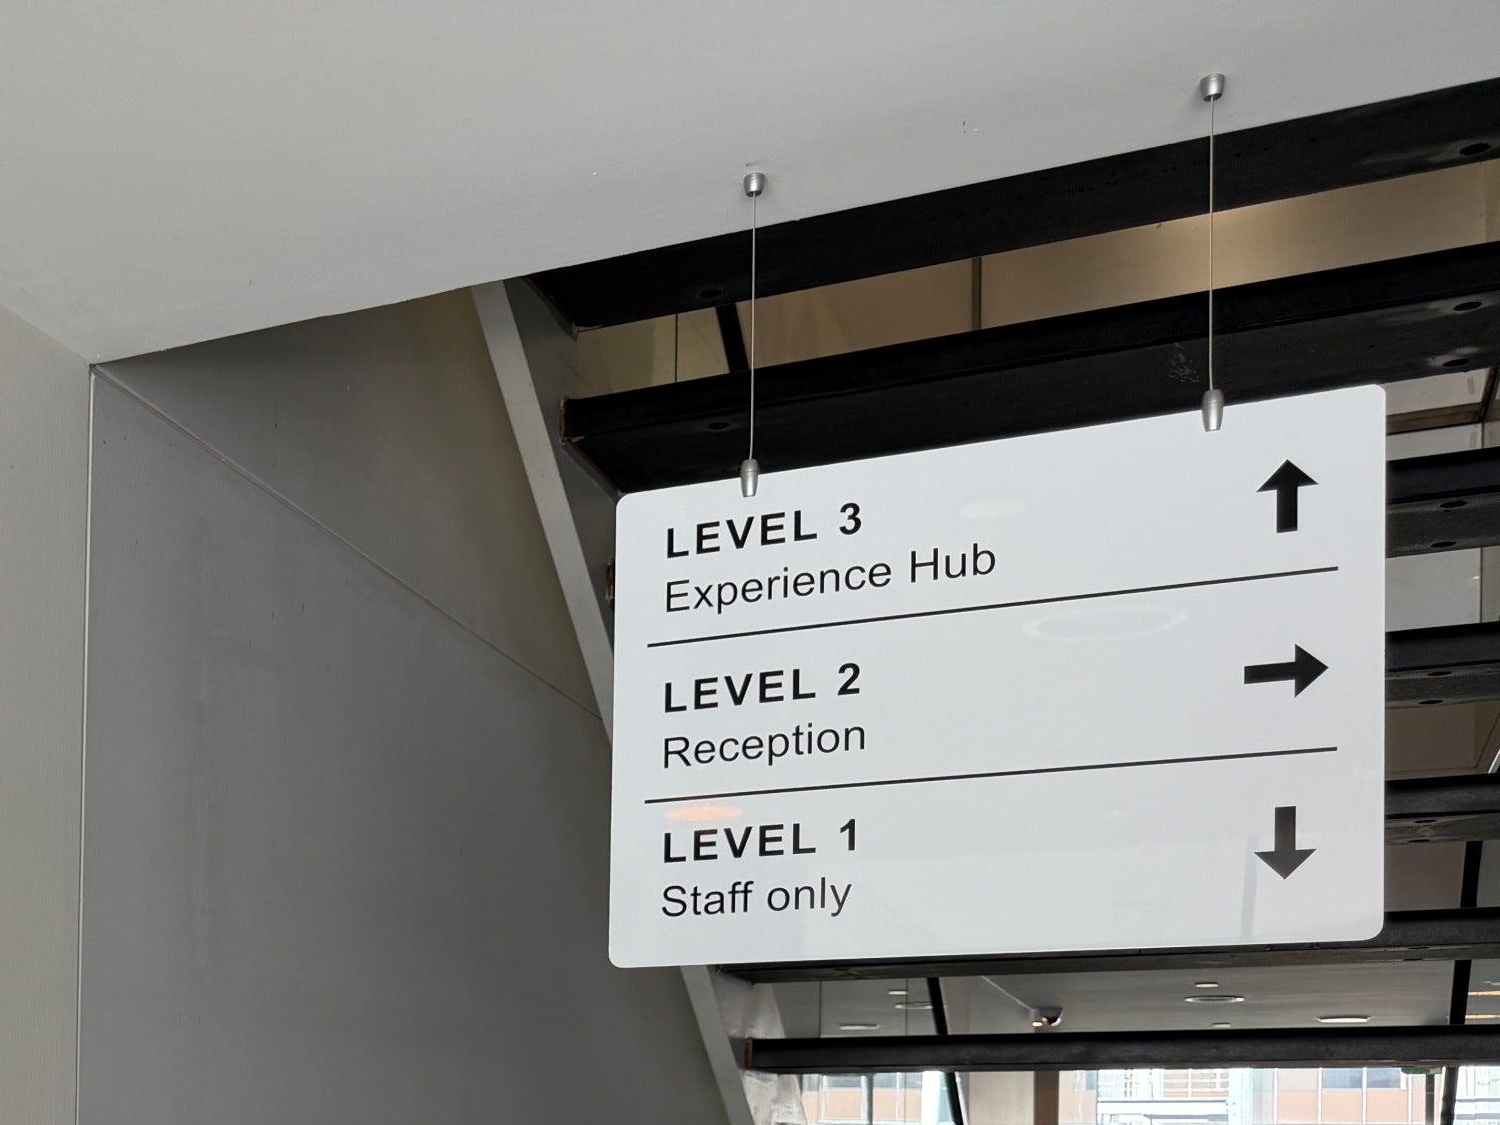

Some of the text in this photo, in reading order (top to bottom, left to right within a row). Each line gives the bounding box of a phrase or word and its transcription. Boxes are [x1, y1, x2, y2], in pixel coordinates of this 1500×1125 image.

[666, 502, 862, 559] LEVEL 3
[666, 542, 997, 615] Experience Hub
[664, 662, 861, 714] LEVEL 2
[663, 722, 866, 769] Reception
[663, 818, 857, 864] LEVEL 1
[661, 876, 853, 918] Staff only
